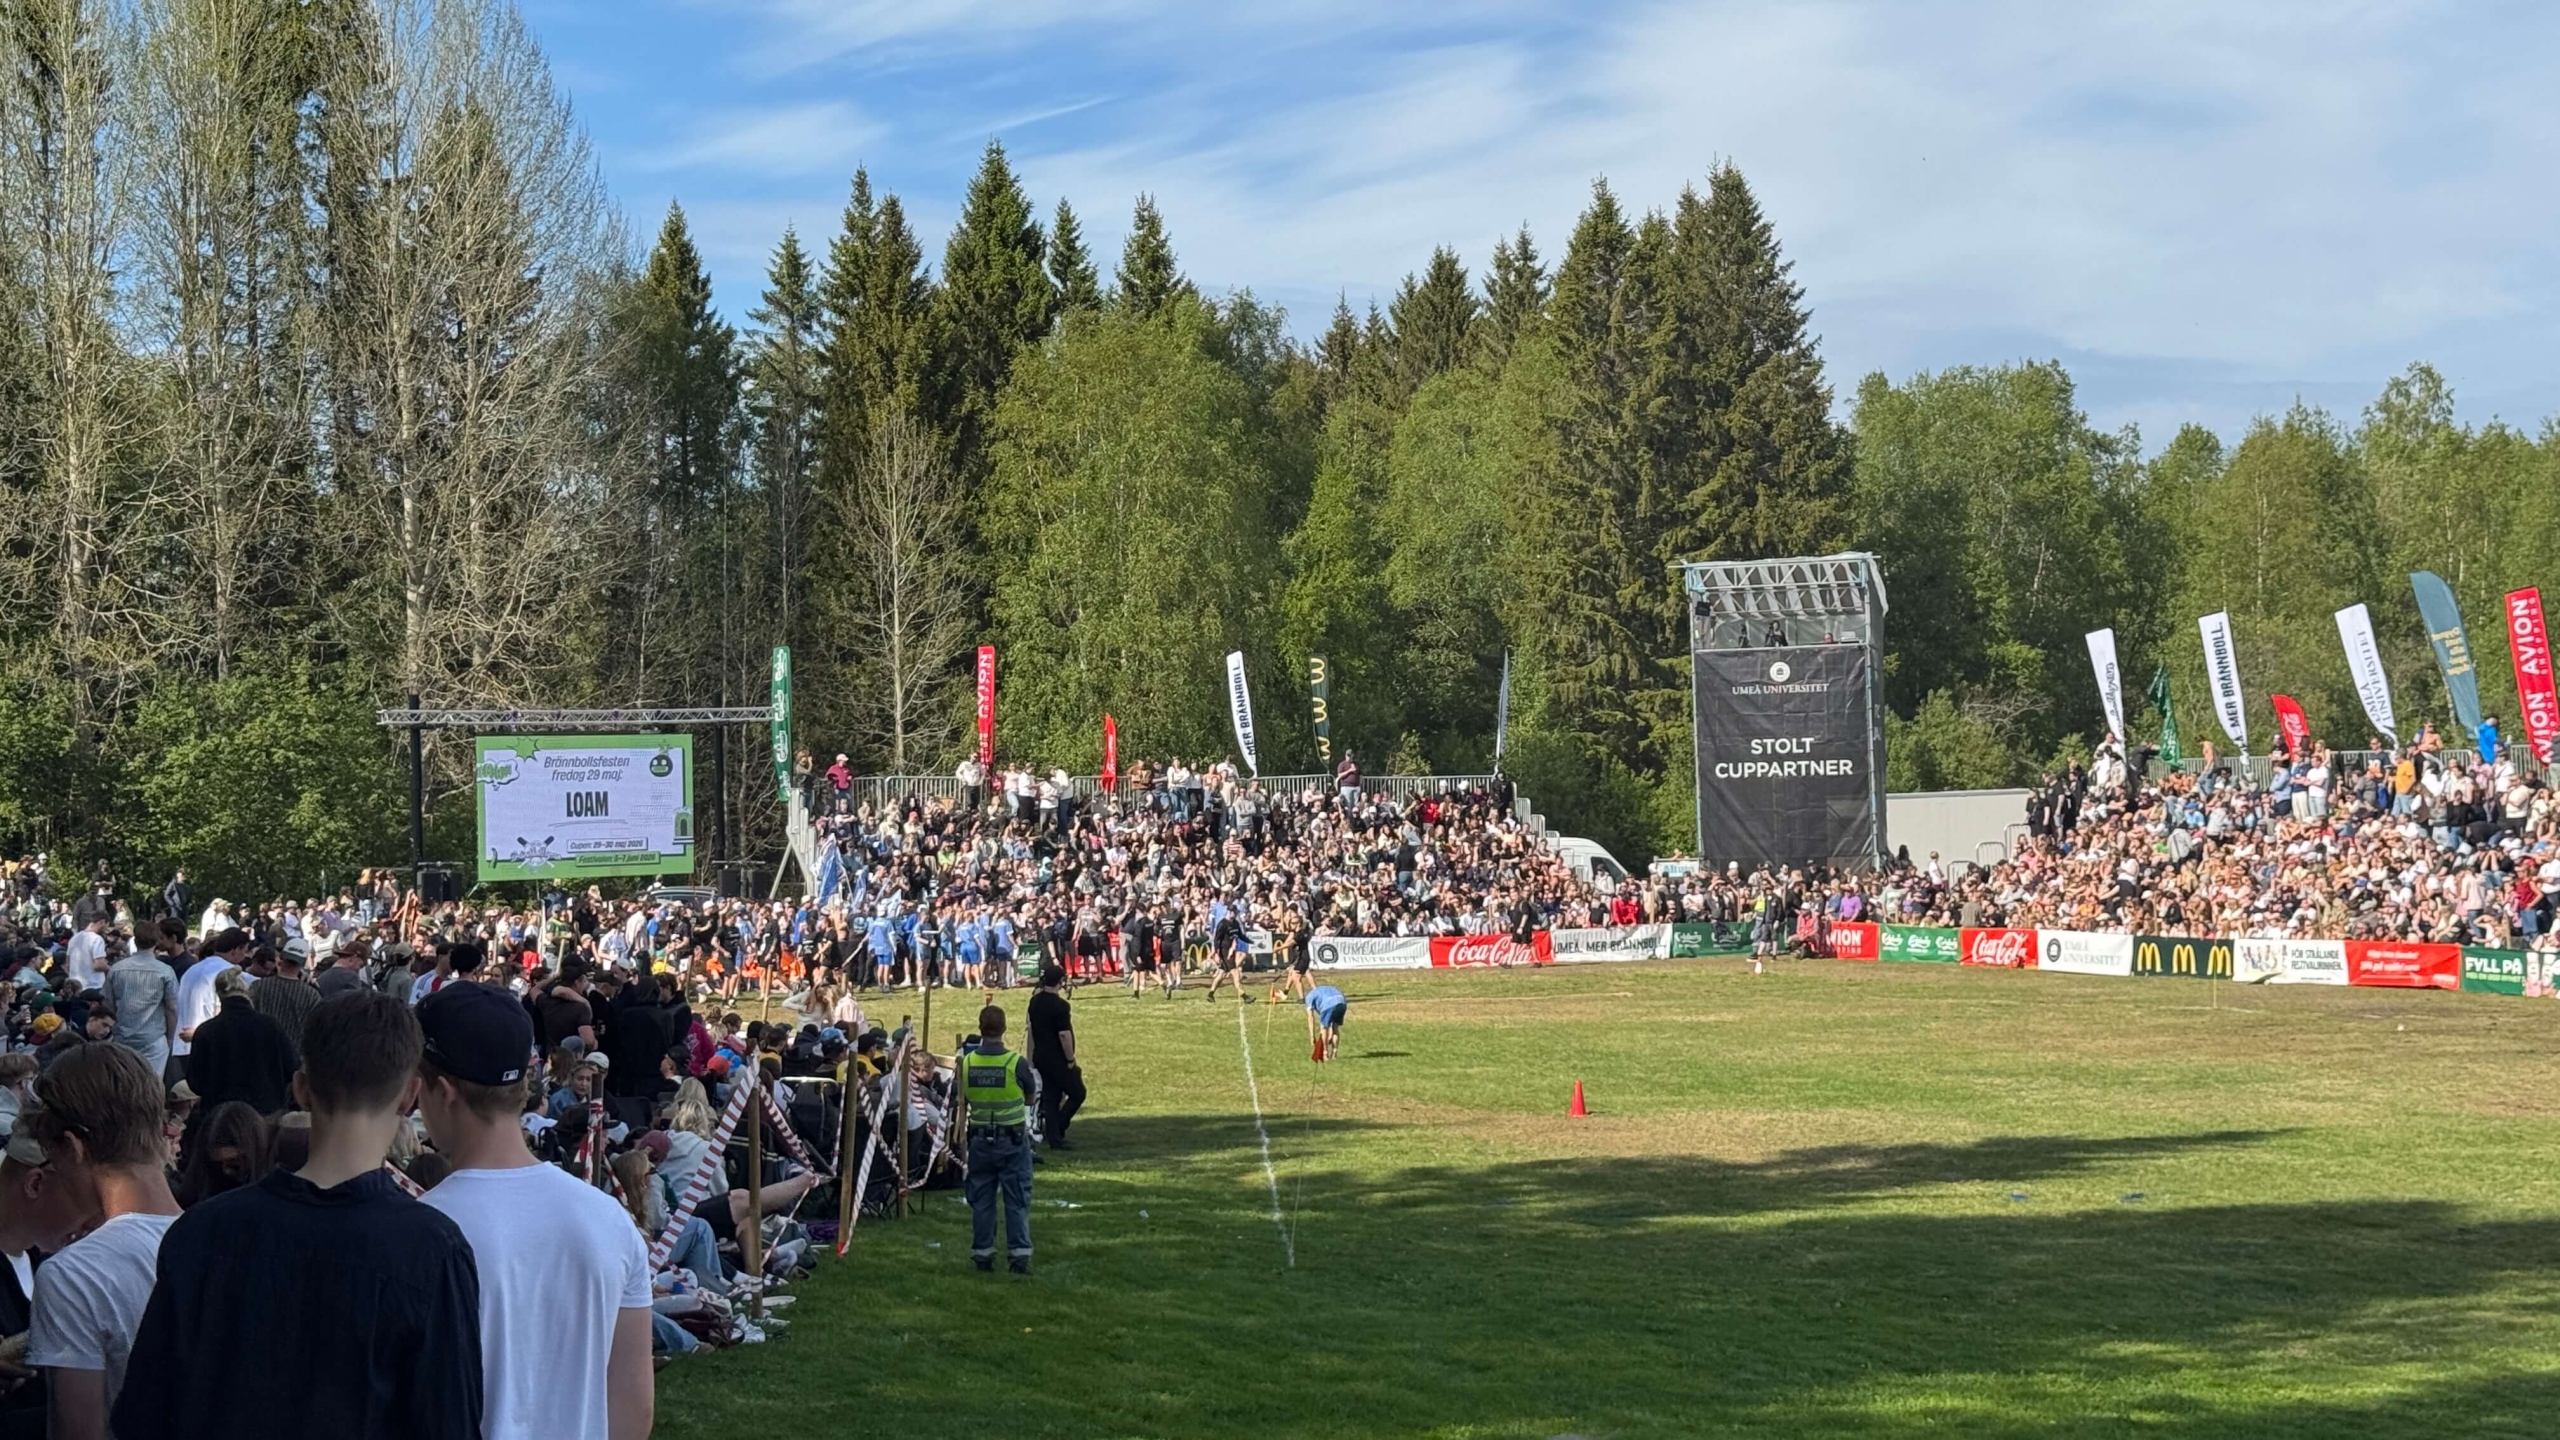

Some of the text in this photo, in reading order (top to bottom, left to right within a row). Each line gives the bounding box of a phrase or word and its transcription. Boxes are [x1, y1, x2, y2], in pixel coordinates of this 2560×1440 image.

[2511, 596, 2539, 676] AVION
[2359, 628, 2391, 724] UNIVERSITET
[1732, 683, 1829, 695] UMEÅ UNIVERSITET
[2228, 699, 2241, 729] MER
[2526, 694, 2554, 764] AVION
[1243, 731, 1257, 756] MER
[1751, 738, 1814, 754] STOLT
[544, 756, 630, 768] Brännbollsfesten
[1715, 759, 1853, 778] CUPPARTNER
[551, 769, 586, 782] fredag
[587, 769, 601, 780] 29
[566, 791, 609, 817] LOAM
[615, 840, 627, 849] maj
[1587, 940, 1608, 952] MER
[2064, 953, 2123, 965] UNIVERSITET
[2465, 957, 2523, 975] FYLL PÅ
[977, 1077, 996, 1086] VAKT
